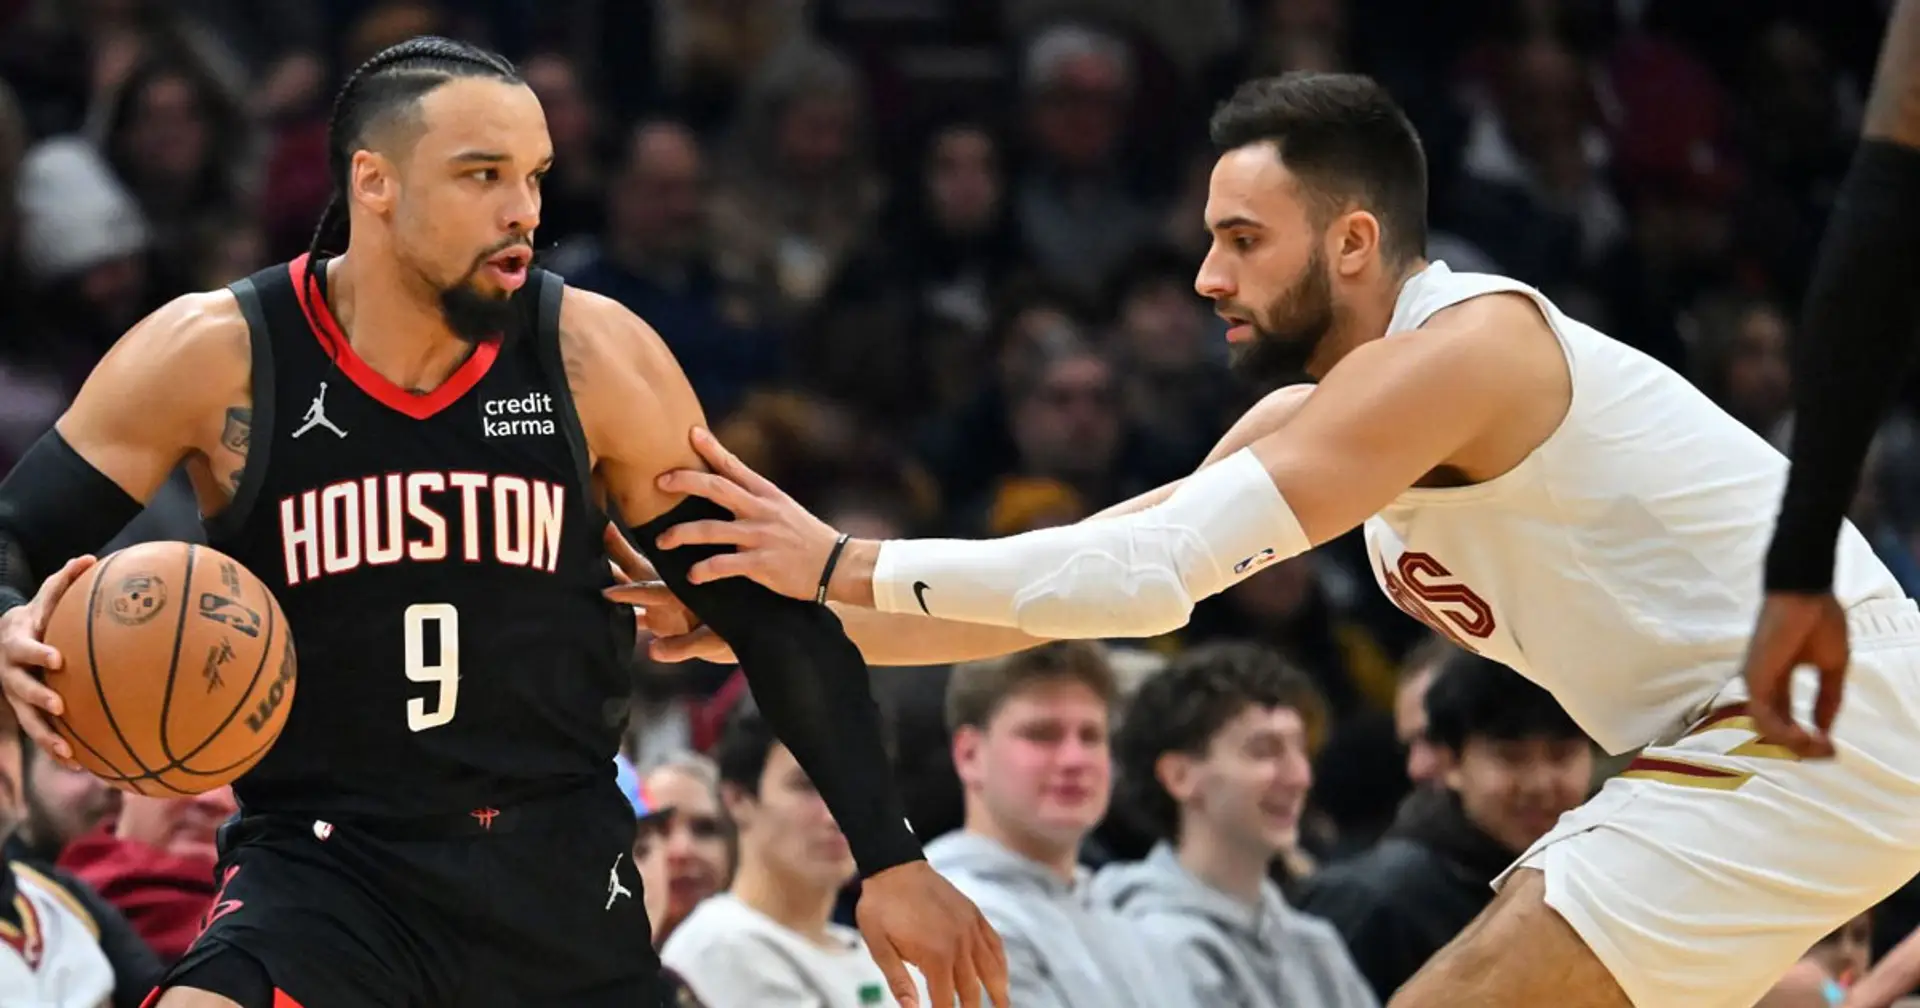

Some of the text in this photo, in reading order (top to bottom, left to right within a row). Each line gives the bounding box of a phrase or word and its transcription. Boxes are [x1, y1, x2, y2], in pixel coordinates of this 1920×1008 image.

[483, 417, 555, 436] karma
[484, 392, 553, 415] credit
[280, 472, 565, 586] HOUSTON
[404, 603, 459, 732] 9
